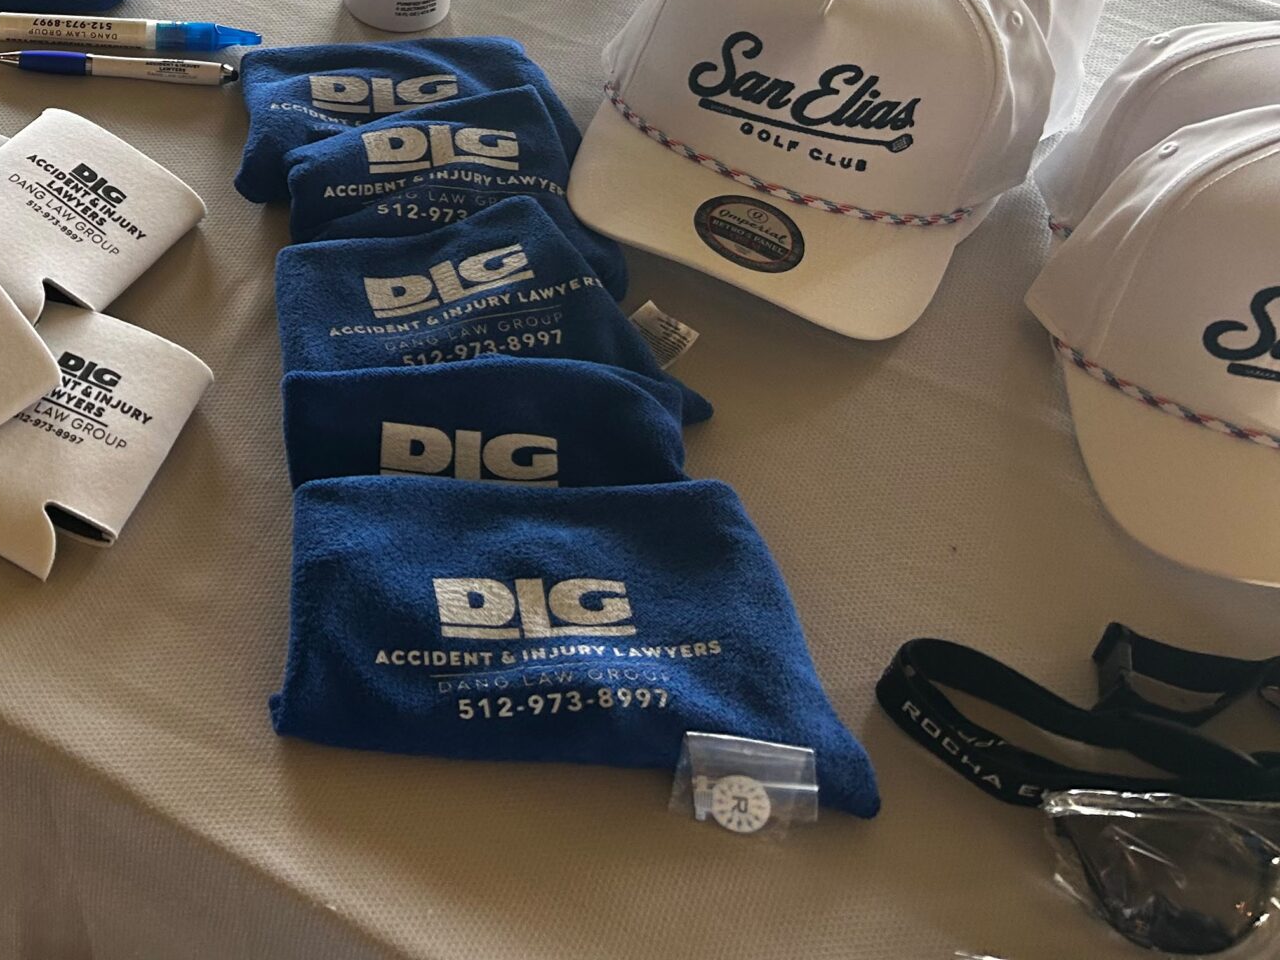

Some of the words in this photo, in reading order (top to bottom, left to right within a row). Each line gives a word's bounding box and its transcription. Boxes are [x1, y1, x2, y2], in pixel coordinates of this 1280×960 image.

[33, 18, 112, 30] 512-973-8997
[66, 30, 86, 38] LAW
[90, 32, 118, 40] DANG
[309, 74, 458, 113] DLG
[688, 31, 795, 110] San
[790, 64, 921, 130] Elias
[362, 125, 519, 174] DLG
[740, 122, 800, 152] GOLF
[809, 148, 867, 172] CLUB
[26, 154, 91, 198] ACCIDENT
[89, 197, 100, 208] &
[99, 205, 147, 240] INJURY
[46, 180, 107, 226] LAWYERS
[68, 163, 127, 208] DLG
[324, 178, 406, 198] ACCIDENT
[429, 170, 492, 186] INJURY
[496, 175, 566, 197] LAWYER
[429, 191, 465, 204] LAW
[8, 173, 46, 200] DANG
[45, 199, 76, 221] LAW
[75, 221, 120, 255] GROUP
[26, 200, 84, 243] 512-973-8997
[377, 203, 468, 223] 512-973
[753, 235, 784, 254] PANEL
[364, 243, 535, 319] DLG
[329, 320, 420, 337] ACCIDENT
[426, 315, 438, 325] &
[442, 294, 511, 321] INJURY
[447, 321, 488, 340] LAW
[497, 311, 563, 333] GROUP
[402, 329, 563, 367] 512-973-8997
[58, 351, 122, 393] DLG
[47, 388, 106, 418] WYERS
[83, 386, 94, 398] &
[94, 390, 153, 425] INJURY
[34, 401, 71, 422] LAW
[71, 417, 127, 450] GROUP
[380, 421, 559, 488] DLG
[432, 577, 636, 640] DLG
[375, 649, 492, 666] ACCIDENT
[501, 651, 516, 664] &
[522, 644, 610, 662] INJURY
[613, 640, 722, 658] LAWYERS
[438, 676, 509, 694] DANG
[523, 670, 574, 688] LAW
[459, 687, 669, 721] 512-973-8997
[902, 700, 1002, 789] ROCHA
